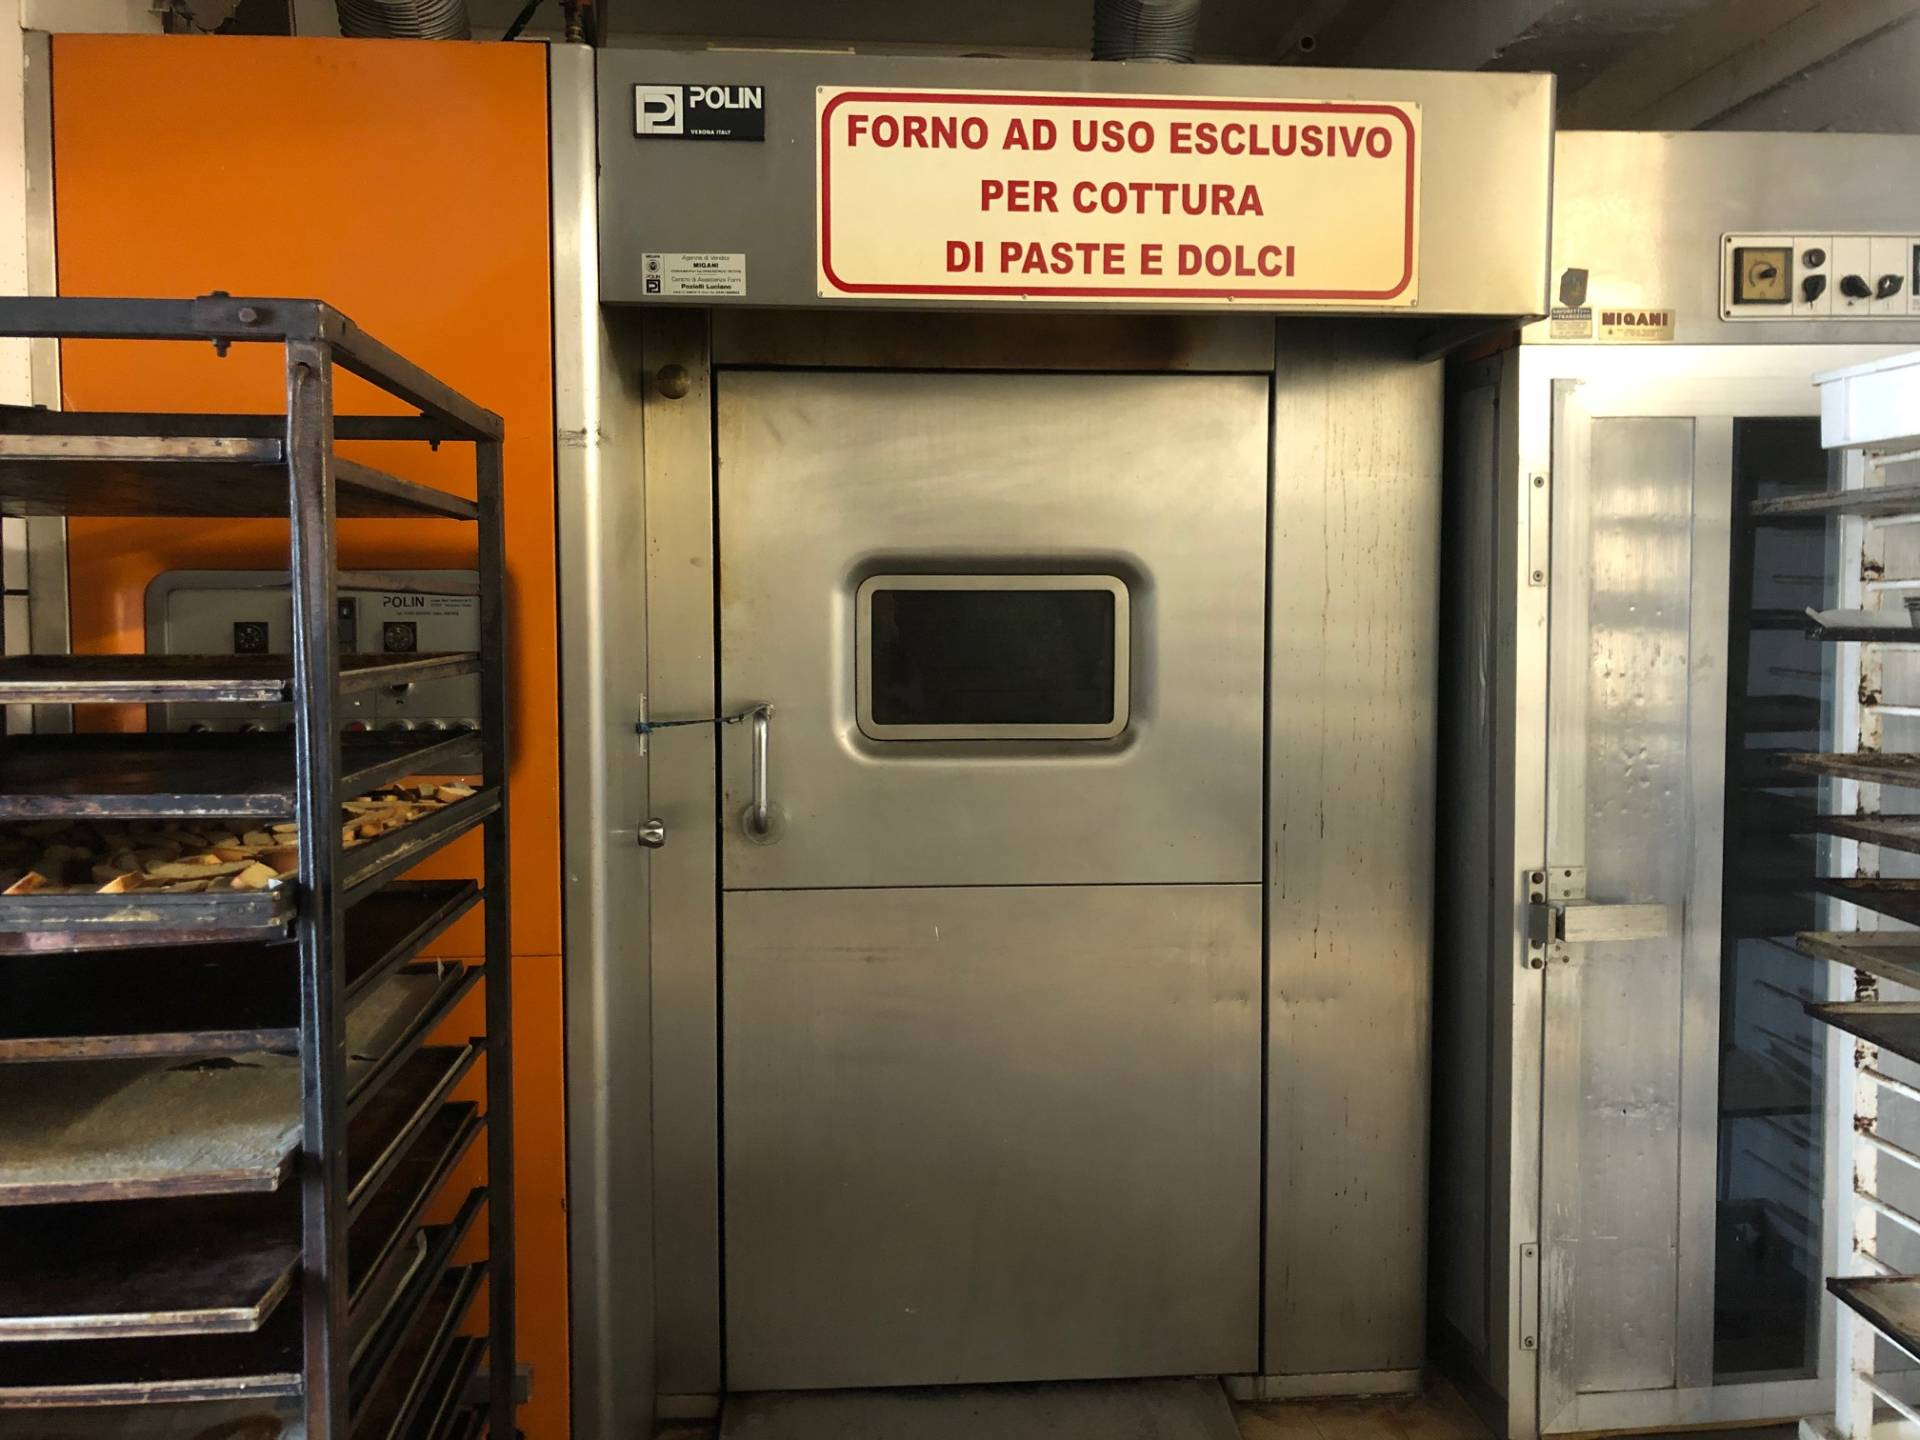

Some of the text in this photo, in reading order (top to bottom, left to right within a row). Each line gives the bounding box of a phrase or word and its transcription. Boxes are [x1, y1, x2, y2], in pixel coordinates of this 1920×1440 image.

[689, 86, 762, 109] POLIN
[847, 114, 1393, 159] FORNO AD USO ESCLUSIVO
[980, 179, 1265, 217] PER COTTURA
[946, 240, 1296, 278] DI PASTE E DOLCI
[383, 596, 424, 607] POLIN
